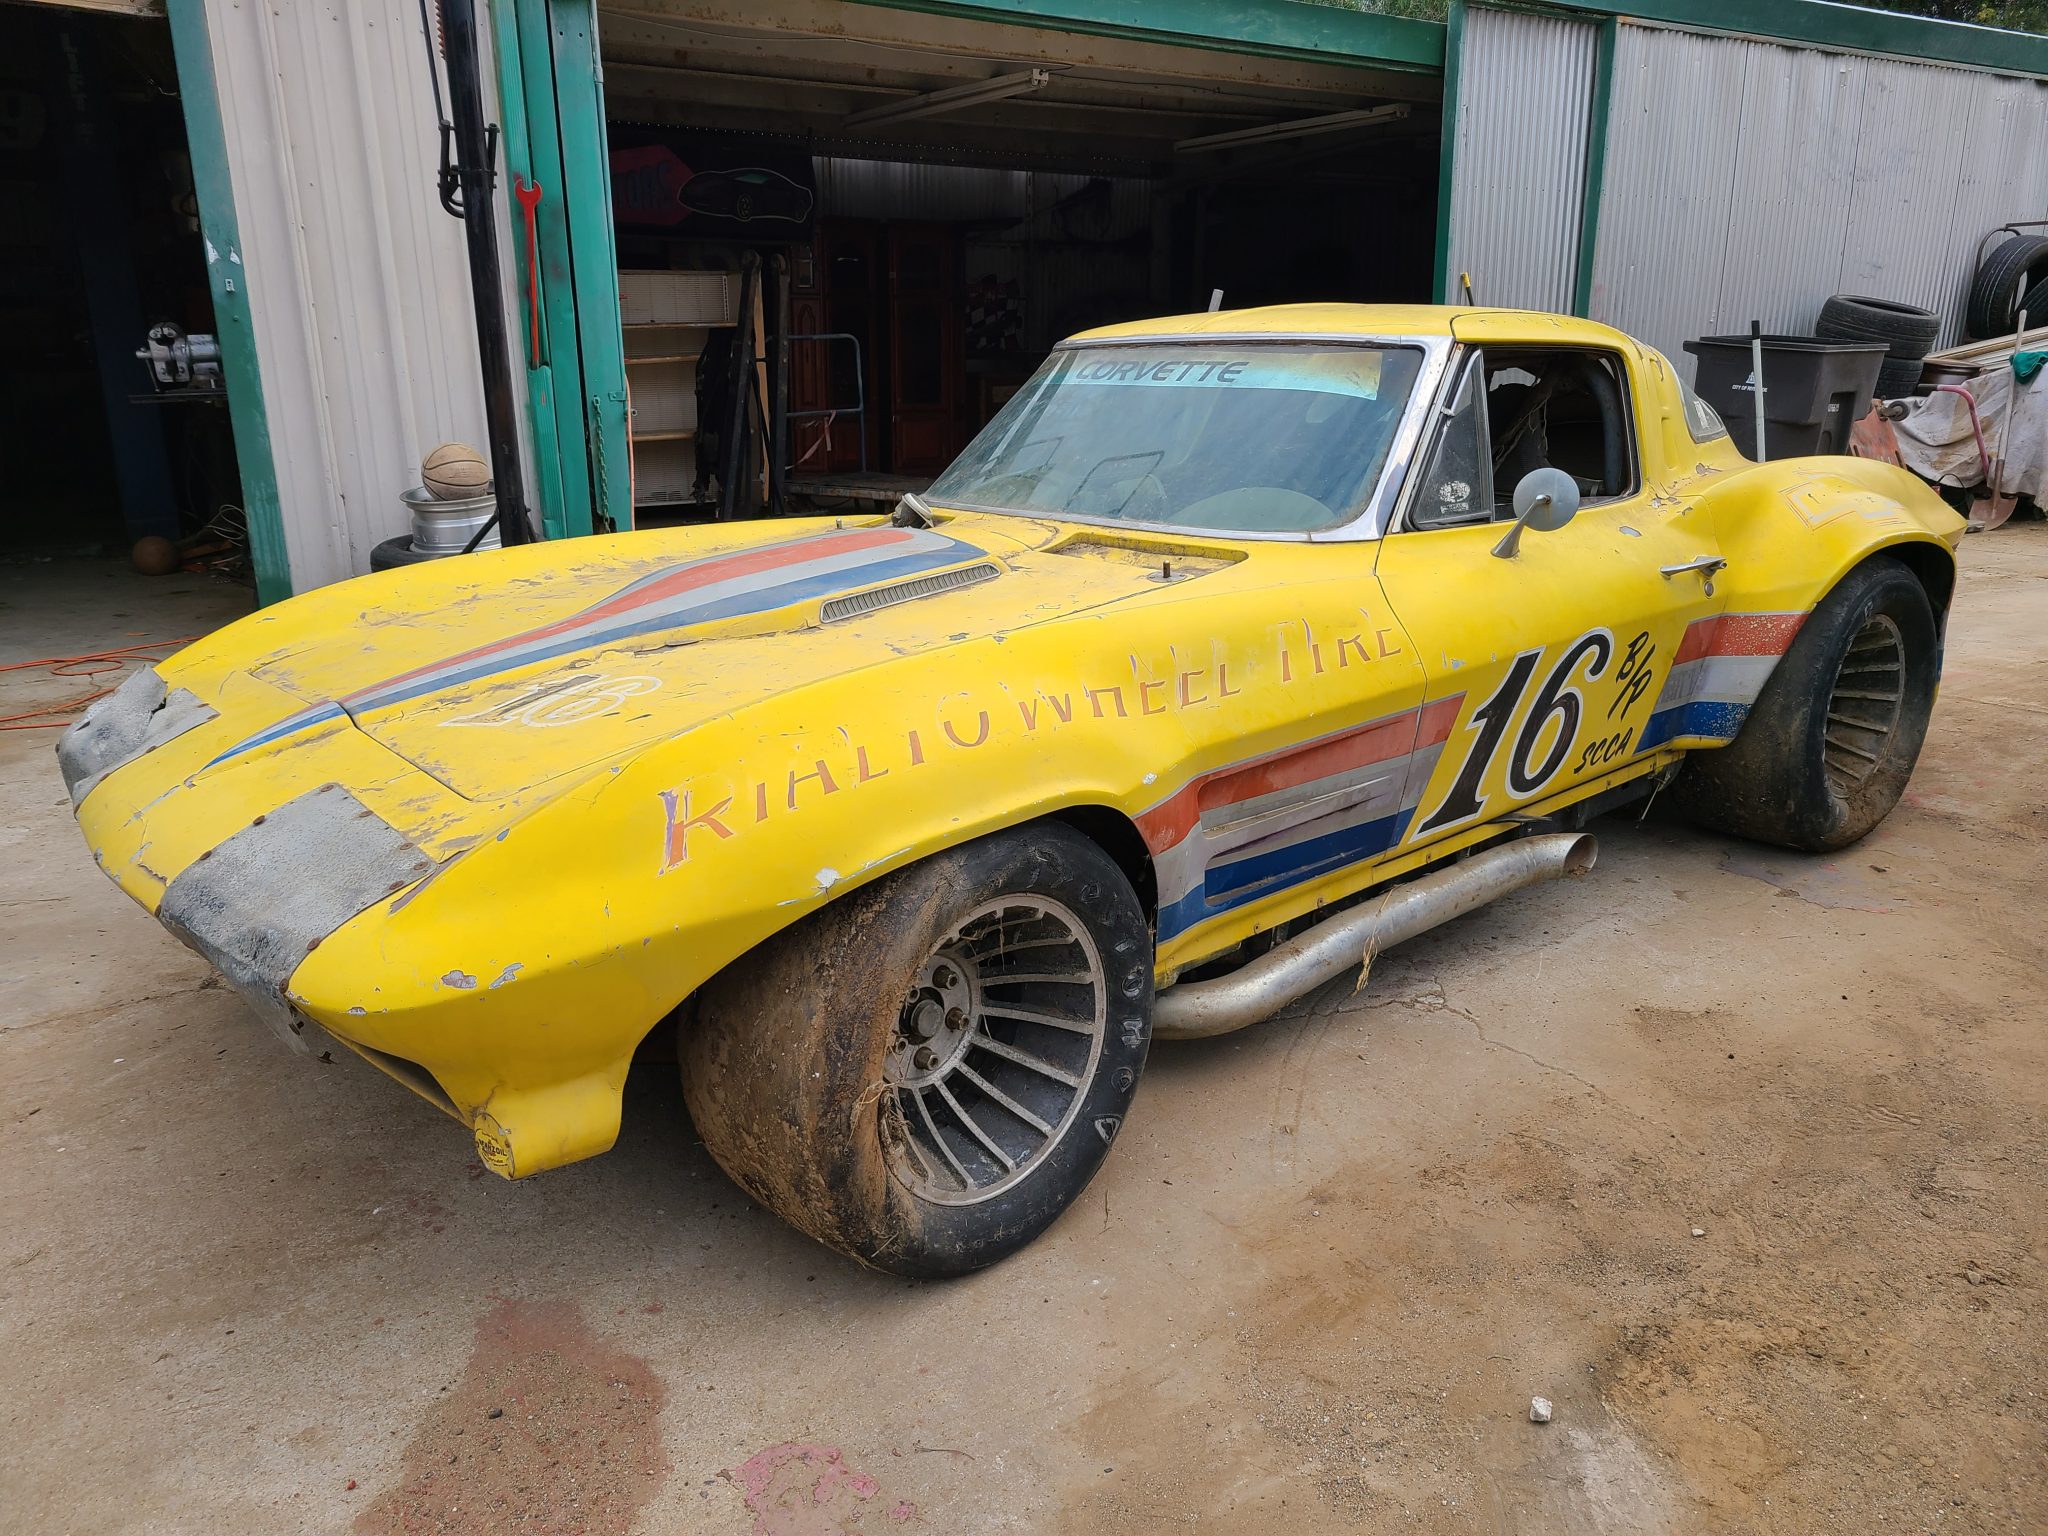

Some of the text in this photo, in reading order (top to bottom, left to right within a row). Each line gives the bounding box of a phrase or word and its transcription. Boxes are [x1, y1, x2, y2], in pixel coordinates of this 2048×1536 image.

[1076, 359, 1250, 384] CORVETTE
[437, 674, 662, 728] 16
[1607, 631, 1656, 722] B/P
[1408, 626, 1615, 842] 16
[1573, 727, 1634, 775] SCCA
